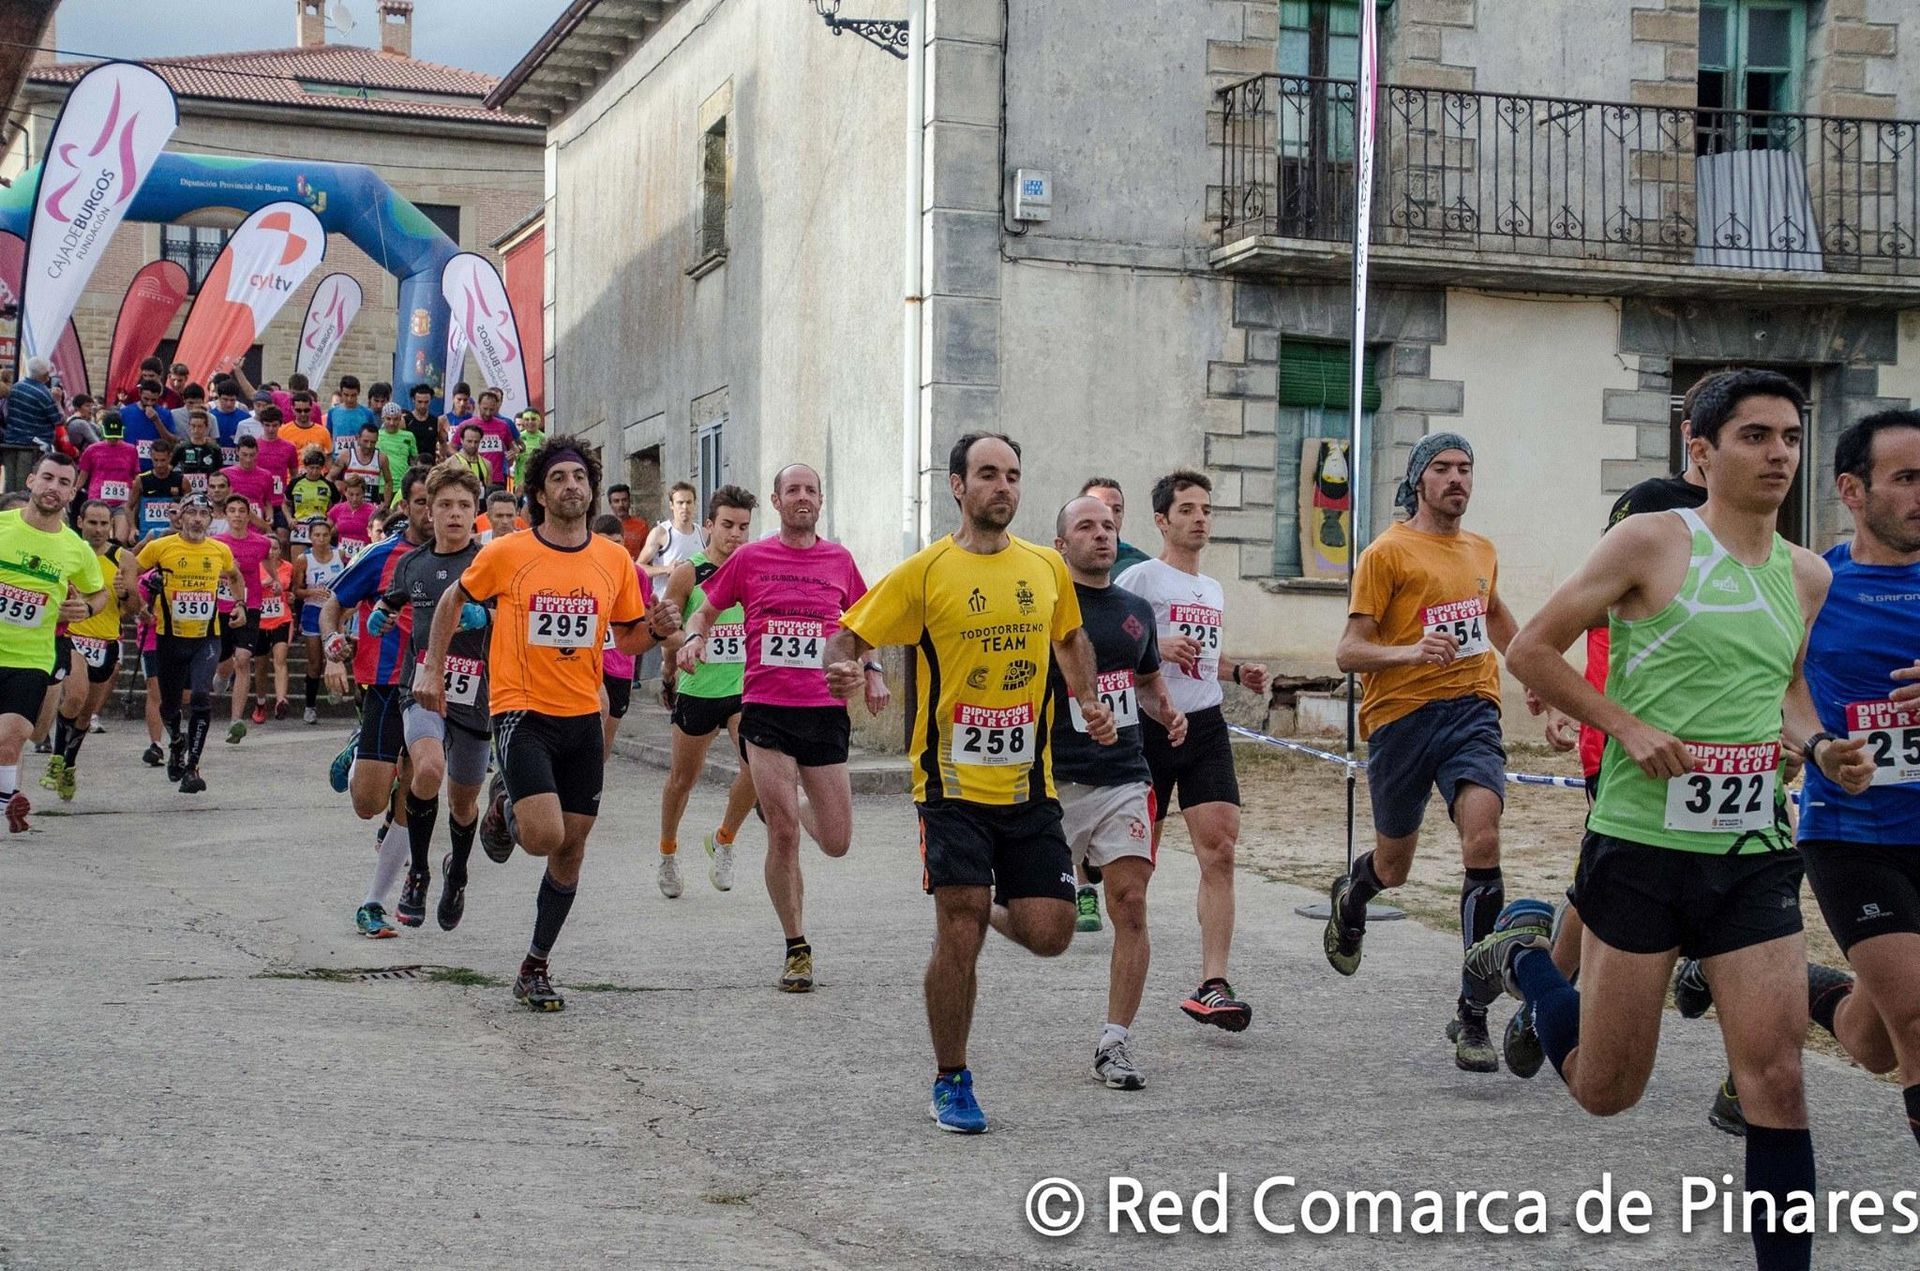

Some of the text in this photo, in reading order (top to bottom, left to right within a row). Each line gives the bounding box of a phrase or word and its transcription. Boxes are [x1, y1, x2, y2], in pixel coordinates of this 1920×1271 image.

[180, 178, 217, 188] Diputación
[219, 181, 253, 190] Provincial
[264, 183, 289, 192] Burgos
[76, 206, 112, 260] FUNDACIÓN
[250, 273, 292, 291] cyltv
[481, 440, 499, 448] 222
[105, 487, 125, 496] 285
[149, 508, 169, 518] 206
[182, 580, 206, 588] TEAM
[0, 597, 36, 620] 359
[178, 602, 208, 614] 350
[260, 604, 280, 614] 245
[536, 603, 594, 613] BURGOS
[537, 596, 594, 607] DIPUTACIÓN
[1427, 599, 1481, 616] DIPUTACIÓN
[1427, 607, 1483, 624] BURGOS
[537, 614, 588, 638] 295
[768, 620, 822, 630] DIPUTACIÓN
[768, 627, 822, 637] BURGOS
[960, 624, 1043, 640] TODOTORREZNO
[770, 637, 817, 659] 234
[981, 637, 1026, 653] TEAM
[963, 705, 1029, 717] DIPUTACIÓN
[961, 714, 1030, 727] BURGOS
[963, 727, 1024, 754] 258
[1685, 743, 1775, 760] DIPUTACIÓN
[1702, 757, 1772, 773] URGOS
[1685, 774, 1764, 815] 322
